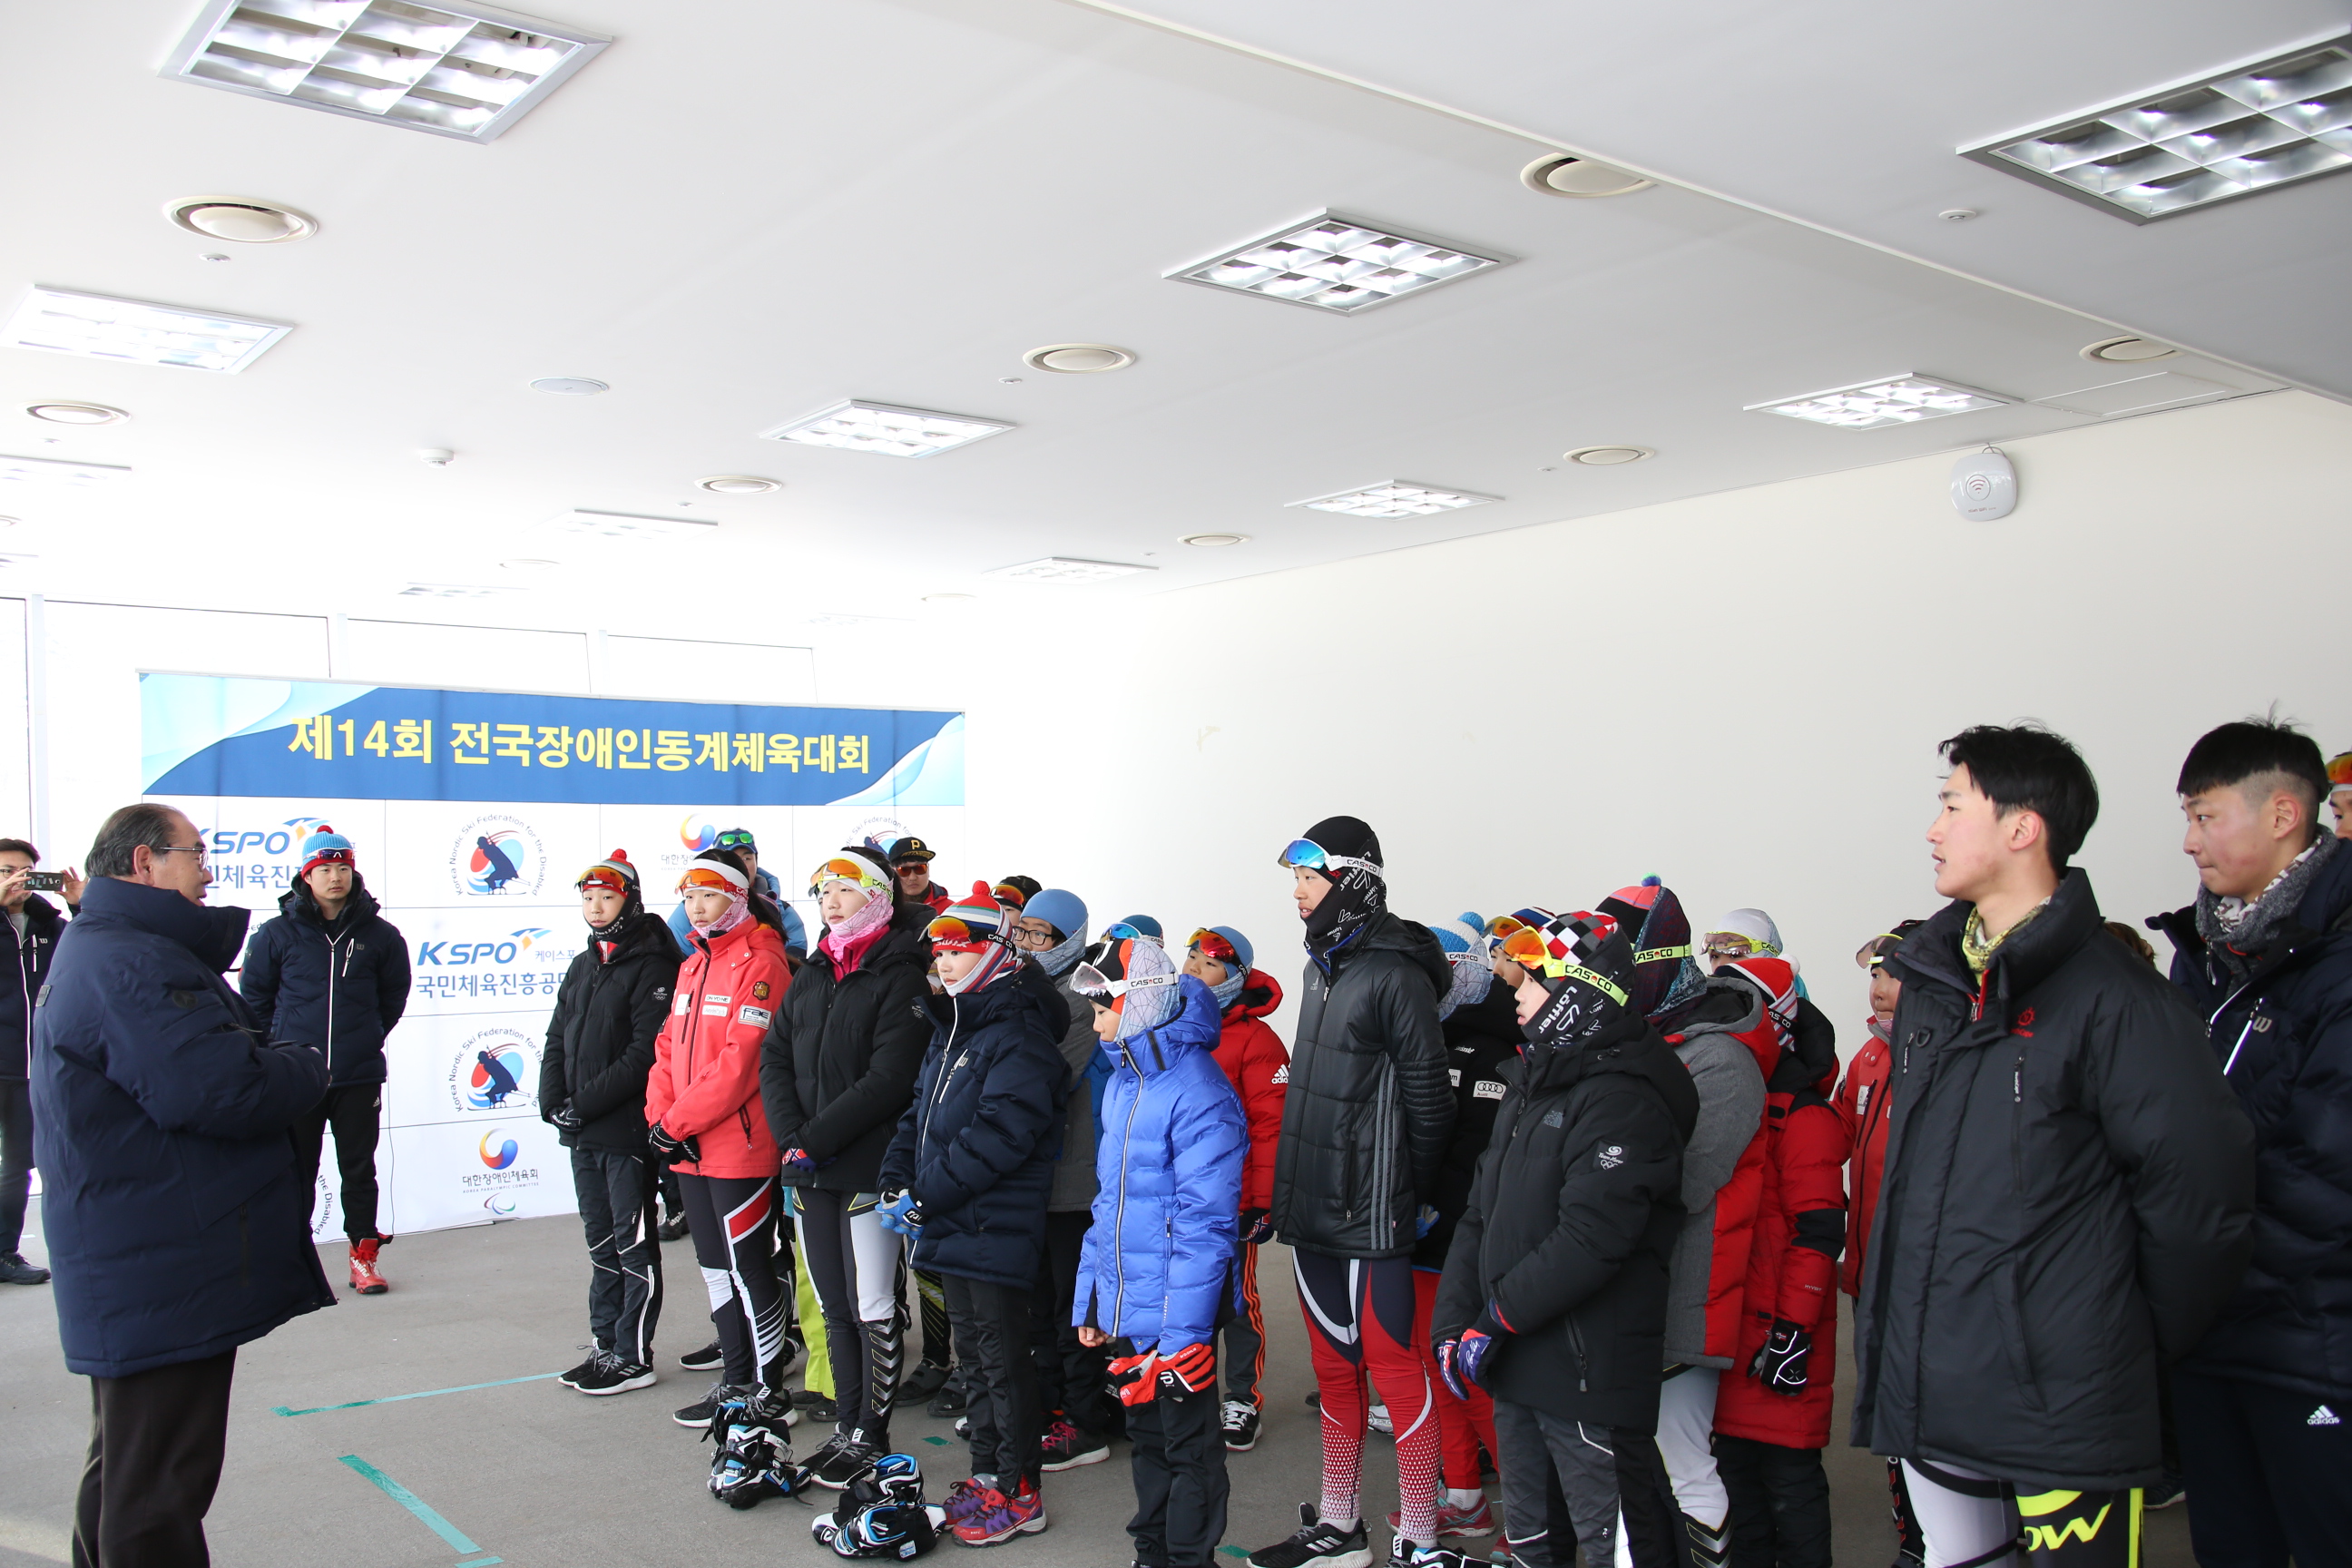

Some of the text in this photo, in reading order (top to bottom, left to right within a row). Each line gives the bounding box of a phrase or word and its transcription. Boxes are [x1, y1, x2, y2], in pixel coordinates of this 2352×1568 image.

[288, 714, 868, 774] 제14회 전국장애인동계체육대회
[851, 822, 863, 835] Ski
[864, 816, 902, 828] Federation
[910, 839, 920, 849] P
[448, 814, 547, 897] Korea Nordic Ski Federation for the Disabled
[416, 941, 517, 965] KSPO
[1449, 954, 1478, 962] CASCO
[1131, 977, 1163, 987] CASCO
[1564, 965, 1612, 993] CASCO
[1538, 985, 1578, 1034] Löffler
[448, 1027, 544, 1112] Korea Nordic Ski Federation for the
[1270, 1075, 1289, 1084] adid
[462, 1168, 539, 1187] 대한장애인체육회
[313, 1174, 333, 1235] the Disabled
[669, 1210, 686, 1227] alpin
